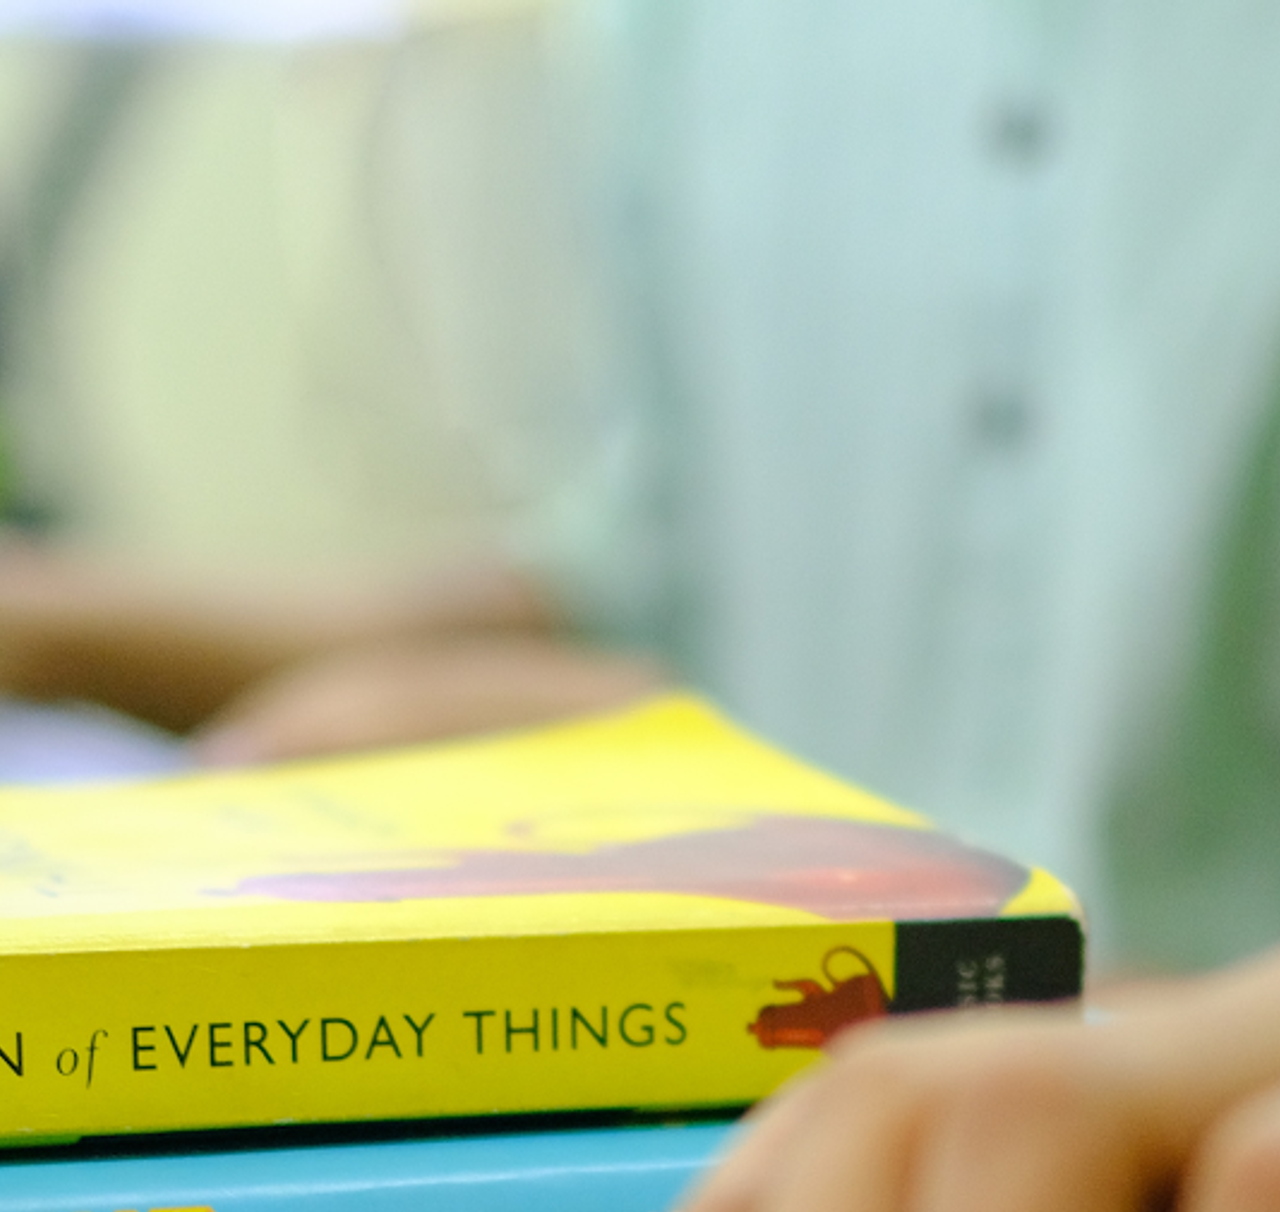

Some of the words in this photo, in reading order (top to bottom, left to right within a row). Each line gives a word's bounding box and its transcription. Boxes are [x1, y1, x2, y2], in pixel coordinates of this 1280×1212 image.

[55, 1028, 109, 1089] of
[130, 1012, 437, 1072] EVERYDAY
[462, 1001, 689, 1056] THINGS
